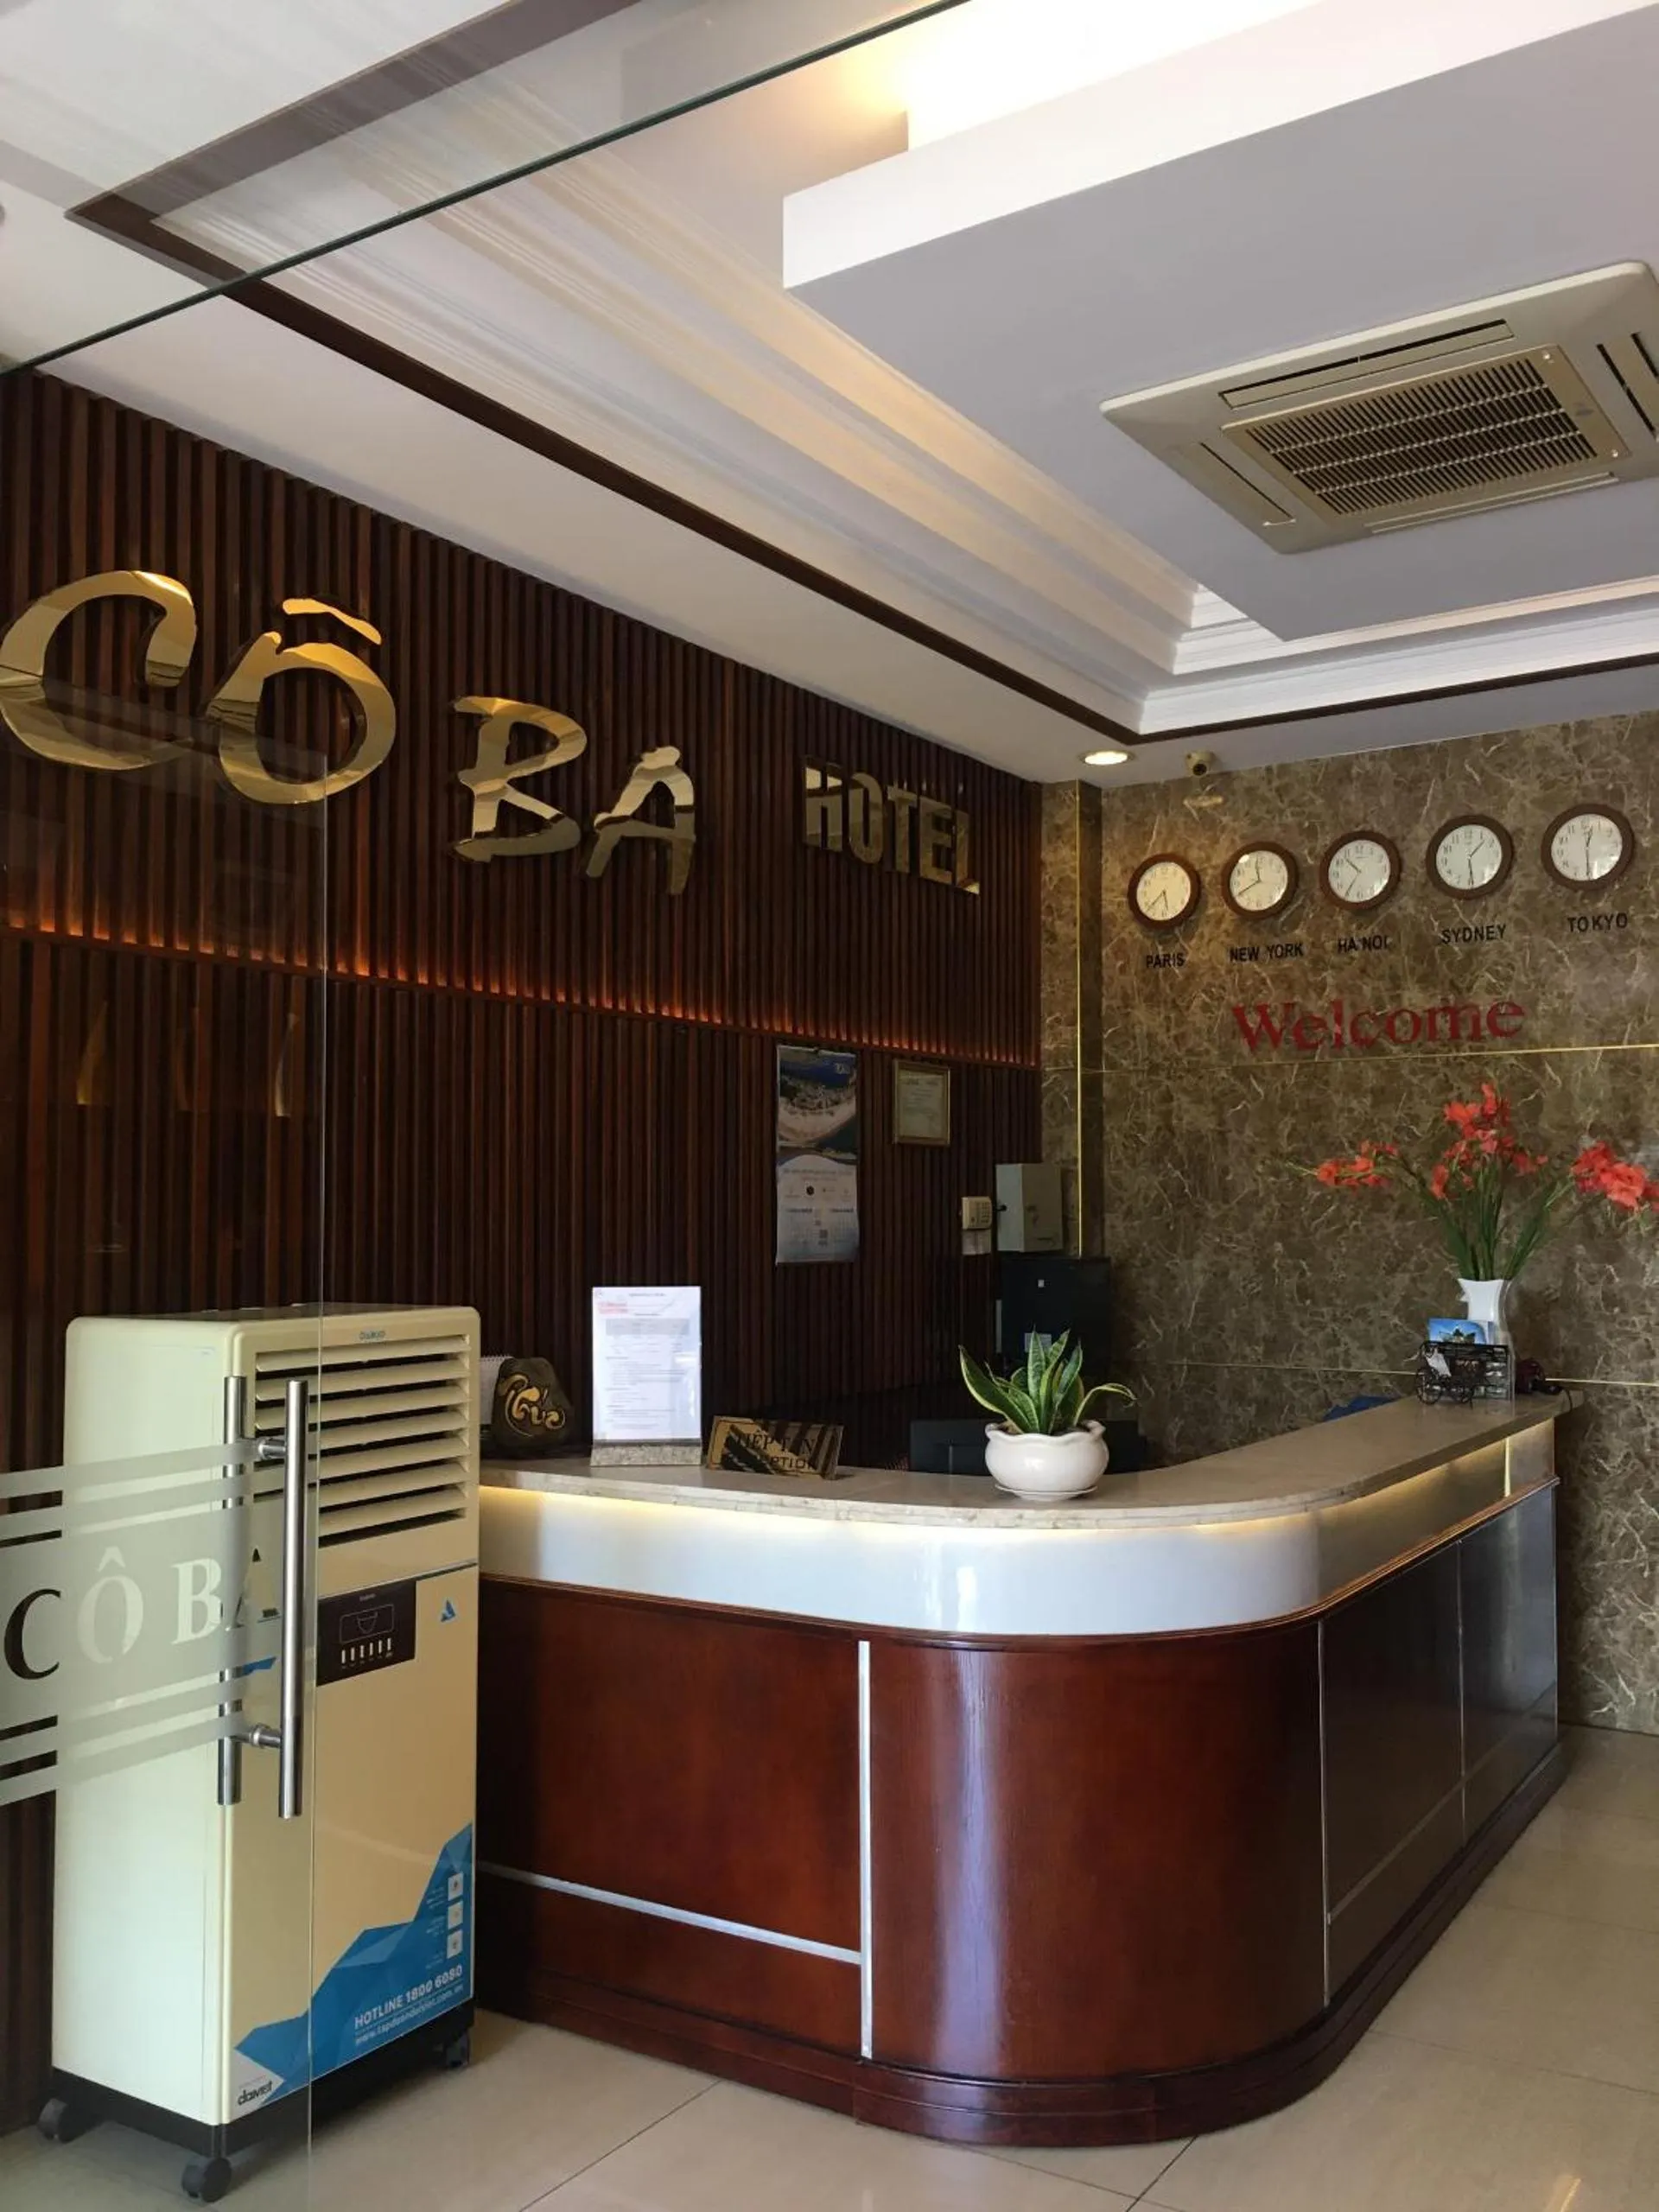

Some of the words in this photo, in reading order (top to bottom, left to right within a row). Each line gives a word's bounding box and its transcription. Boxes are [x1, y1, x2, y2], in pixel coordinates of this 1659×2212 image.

[454, 695, 696, 895] BA
[804, 761, 981, 895] HOTEL
[1567, 912, 1628, 932] TOKYO
[1441, 924, 1507, 944] SYDNEY
[1146, 952, 1186, 969] PARIS
[1230, 946, 1260, 963] NEW
[1266, 943, 1305, 960] YORK
[1231, 999, 1527, 1054] Welcome
[354, 1994, 404, 2030] HOTLINE
[405, 1980, 434, 2003] 1800
